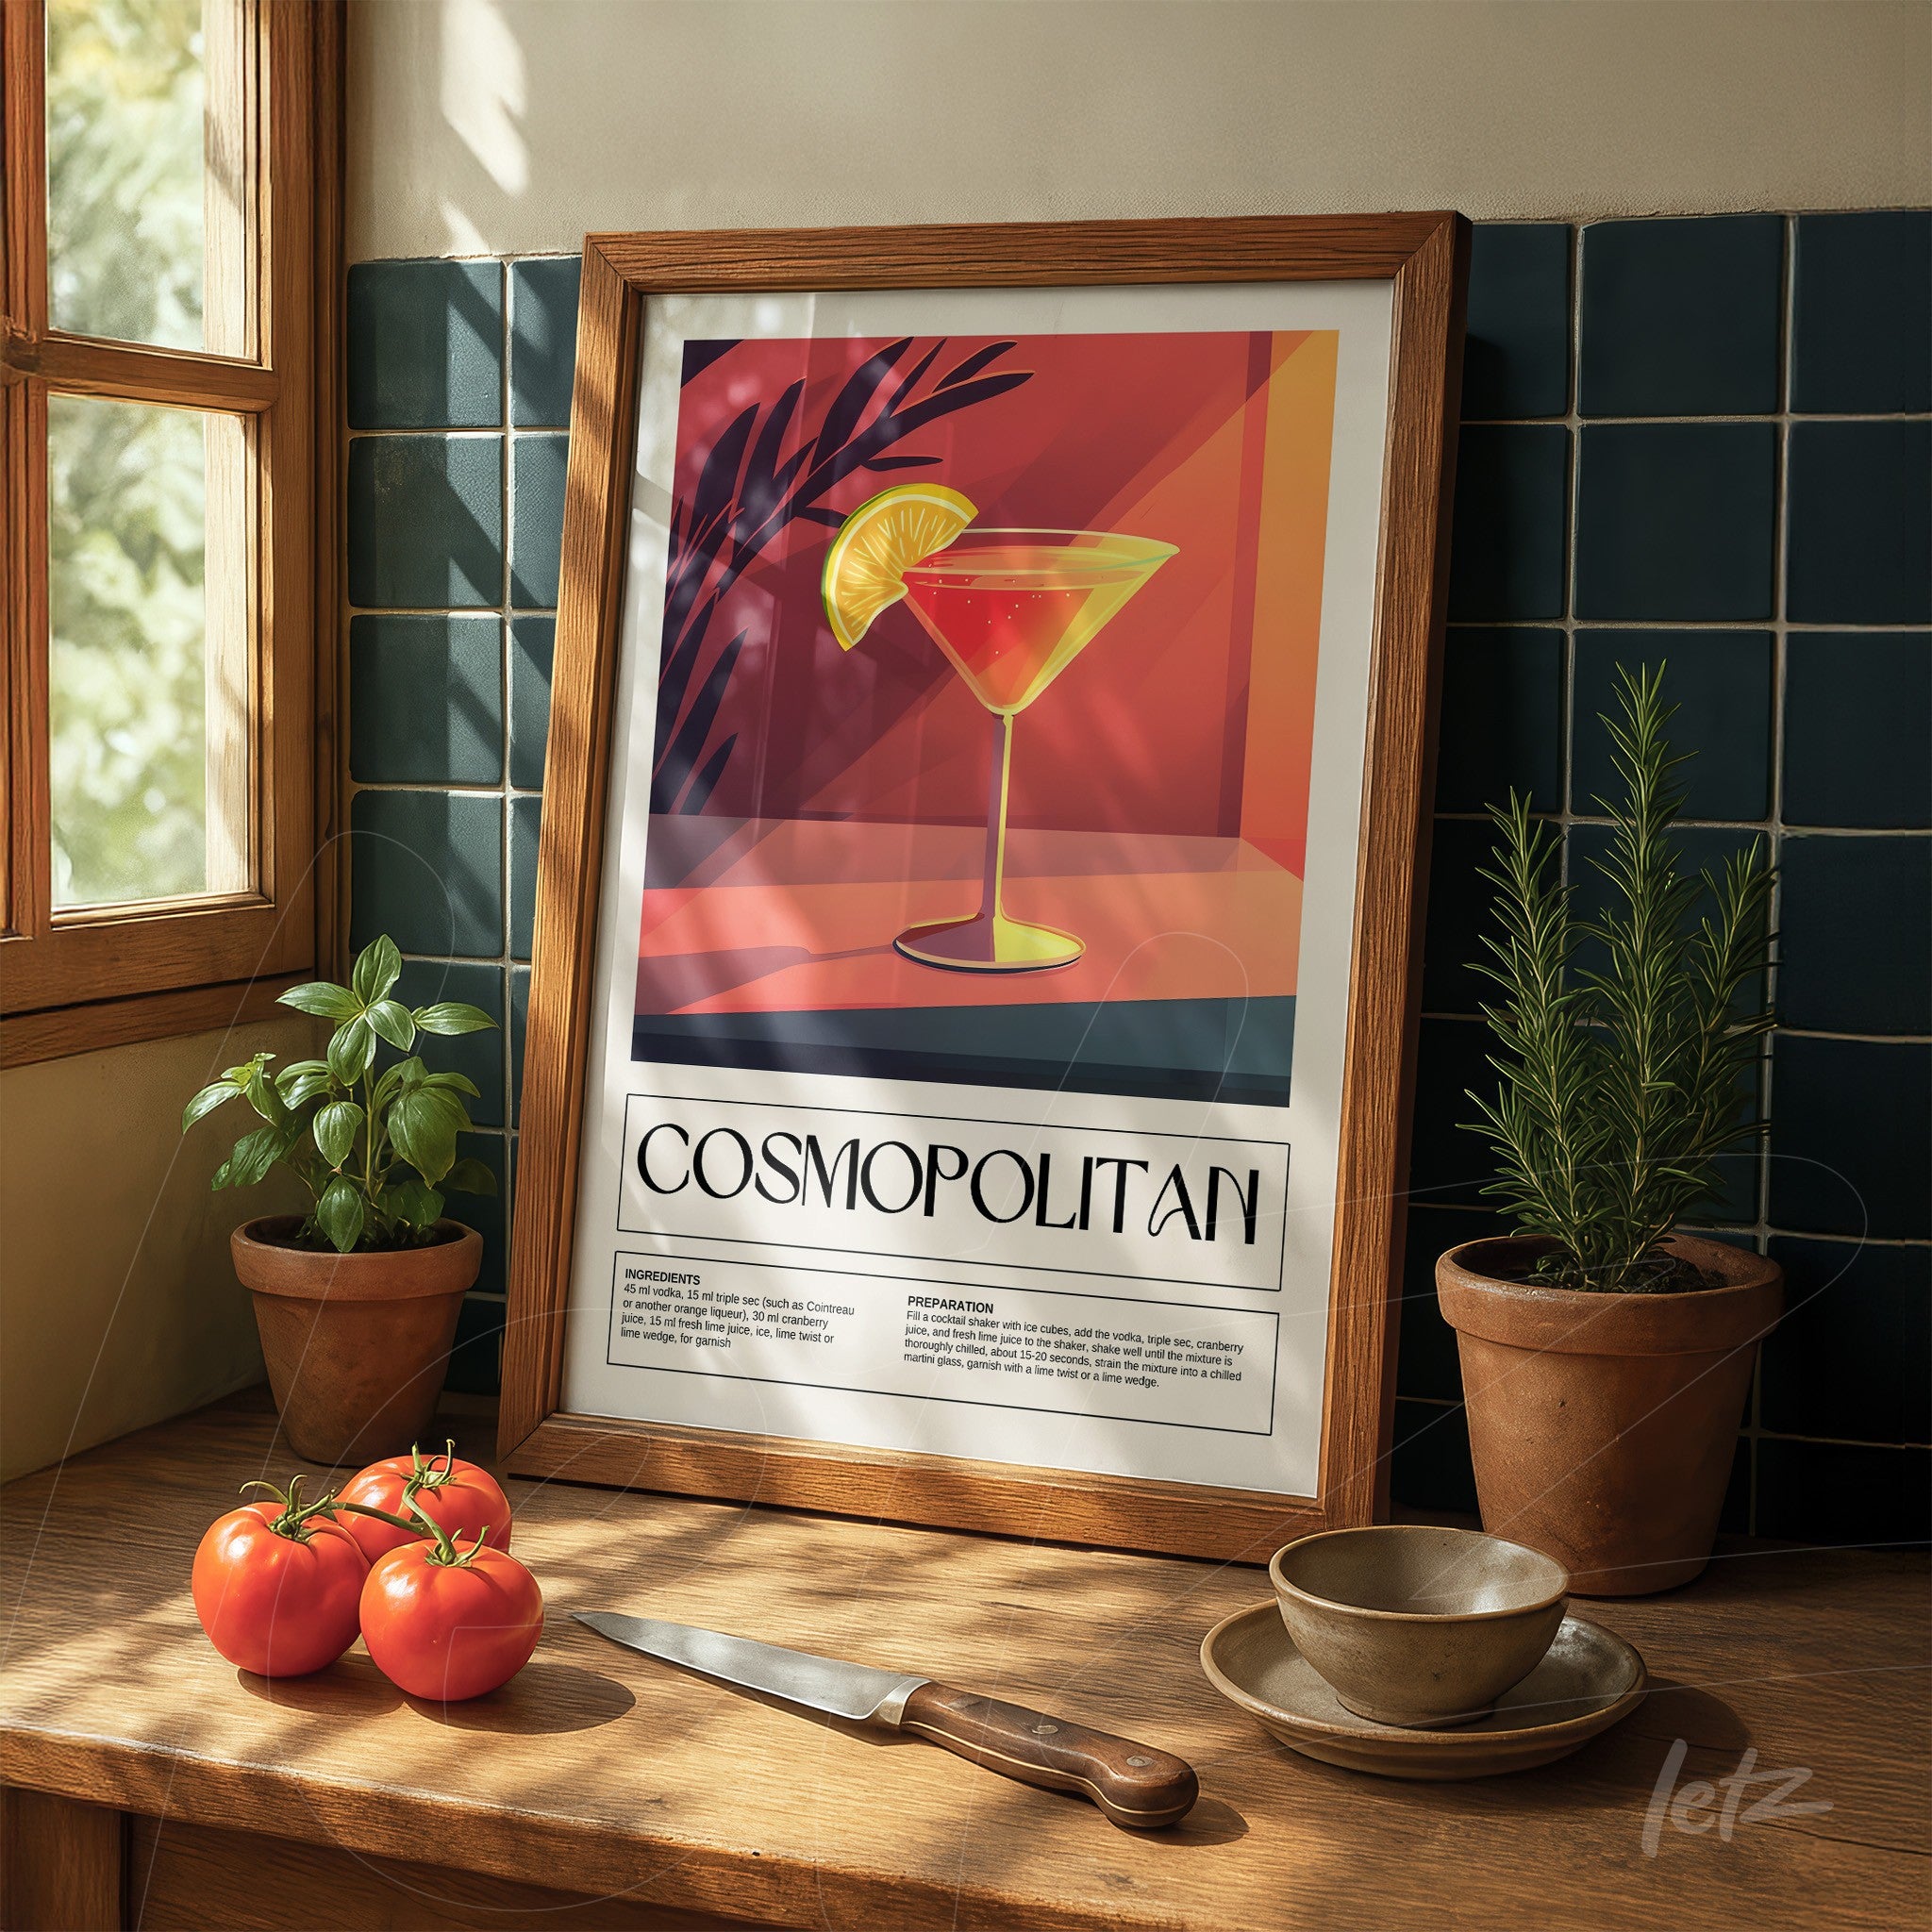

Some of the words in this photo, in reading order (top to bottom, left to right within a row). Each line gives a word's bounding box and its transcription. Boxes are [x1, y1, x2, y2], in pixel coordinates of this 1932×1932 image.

[637, 1123, 1260, 1245] COSMOPOLITAN
[625, 1269, 700, 1285] INGREDIENTS
[623, 1299, 634, 1308] or
[634, 1300, 673, 1312] another
[674, 1305, 708, 1319] orange
[710, 1306, 749, 1323] liqueur),
[752, 1309, 765, 1323] 30
[767, 1312, 779, 1324] ml
[781, 1315, 829, 1331] cranberry
[624, 1283, 637, 1294] 45
[638, 1285, 651, 1295] ml
[652, 1287, 684, 1300] vodka,
[687, 1289, 700, 1301] 15
[702, 1291, 714, 1302] ml
[716, 1292, 741, 1306] triple
[741, 1296, 760, 1307] sec
[762, 1296, 790, 1310] (such
[791, 1302, 804, 1311] as
[807, 1300, 855, 1316] Cointreau
[908, 1296, 993, 1314] PREPARATION
[621, 1311, 647, 1326] juice,
[649, 1315, 662, 1326] 15
[664, 1317, 676, 1328] ml
[677, 1317, 703, 1331] fresh
[705, 1320, 725, 1333] lime
[726, 1323, 753, 1338] juice,
[756, 1325, 773, 1340] ice,
[775, 1327, 796, 1341] lime
[798, 1330, 822, 1343] twist
[824, 1335, 835, 1343] or
[621, 1326, 641, 1339] lime
[642, 1330, 677, 1344] wedge,
[679, 1332, 694, 1344] for
[695, 1336, 732, 1349] garnish
[907, 1310, 921, 1321] Fill
[923, 1313, 929, 1323] a
[930, 1314, 966, 1325] cocktail
[968, 1317, 1001, 1329] shaker
[1002, 1320, 1022, 1331] with
[1024, 1321, 1038, 1333] ice
[1040, 1324, 1072, 1338] cubes,
[1074, 1327, 1093, 1339] add
[1094, 1328, 1110, 1340] the
[1112, 1332, 1145, 1345] vodka,
[1147, 1334, 1172, 1347] triple
[1174, 1338, 1194, 1350] sec,
[1196, 1341, 1244, 1356] cranberry
[905, 1324, 930, 1338] juice,
[932, 1327, 951, 1338] and
[953, 1328, 976, 1341] fresh
[977, 1330, 998, 1343] lime
[999, 1333, 1023, 1345] juice
[1024, 1337, 1035, 1347] to
[1036, 1337, 1052, 1348] the
[1053, 1339, 1089, 1353] shaker,
[1091, 1342, 1121, 1356] shake
[1123, 1346, 1142, 1357] well
[1144, 1349, 1166, 1359] until
[1167, 1350, 1183, 1361] the
[1185, 1352, 1223, 1366] mixture
[1224, 1355, 1233, 1367] is
[905, 1338, 954, 1355] thoroughly
[955, 1343, 989, 1357] chilled,
[990, 1347, 1018, 1358] about
[1020, 1349, 1048, 1362] 15-20
[1049, 1354, 1092, 1368] seconds,
[1094, 1358, 1122, 1370] strain
[1124, 1359, 1140, 1372] the
[1141, 1362, 1178, 1375] mixture
[1180, 1365, 1199, 1377] into
[1200, 1370, 1208, 1378] a
[1209, 1369, 1242, 1382] chilled
[904, 1353, 936, 1364] martini
[937, 1355, 964, 1369] glass,
[966, 1359, 1002, 1372] garnish
[1004, 1362, 1024, 1374] with
[1025, 1366, 1032, 1374] a
[1034, 1364, 1055, 1377] lime
[1057, 1368, 1079, 1379] twist
[1080, 1371, 1091, 1380] or
[1092, 1373, 1100, 1382] a
[1102, 1372, 1123, 1384] lime
[1124, 1375, 1159, 1389] wedge.
